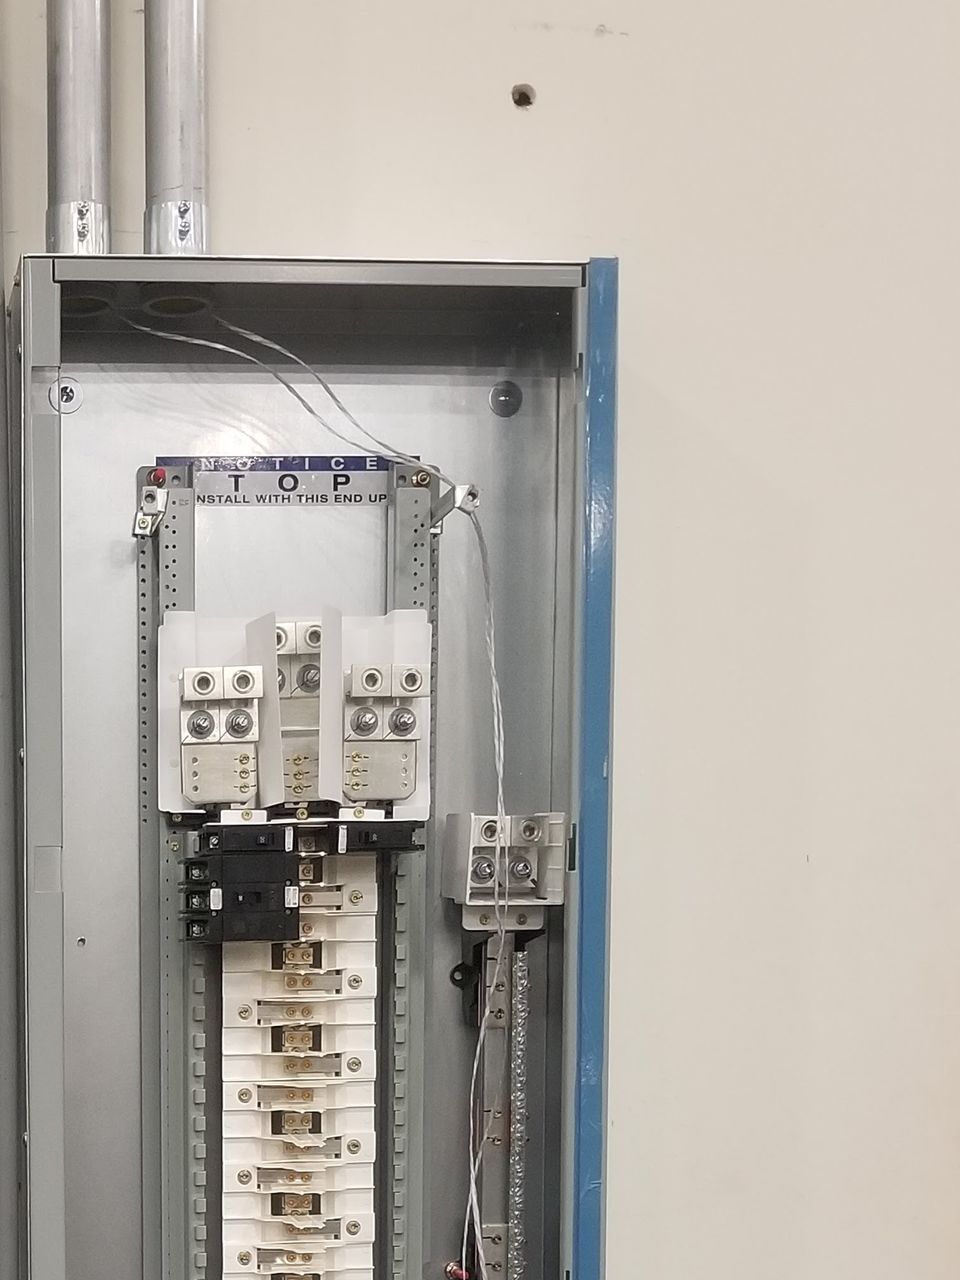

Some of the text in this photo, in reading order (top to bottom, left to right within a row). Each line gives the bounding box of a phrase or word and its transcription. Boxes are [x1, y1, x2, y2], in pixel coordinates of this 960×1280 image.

[200, 457, 378, 471] NOTICE
[228, 473, 351, 492] TOP
[196, 494, 250, 504] NSTALL
[256, 494, 291, 504] WITH
[296, 493, 328, 503] THIS
[334, 493, 363, 503] END
[368, 493, 388, 503] UP
